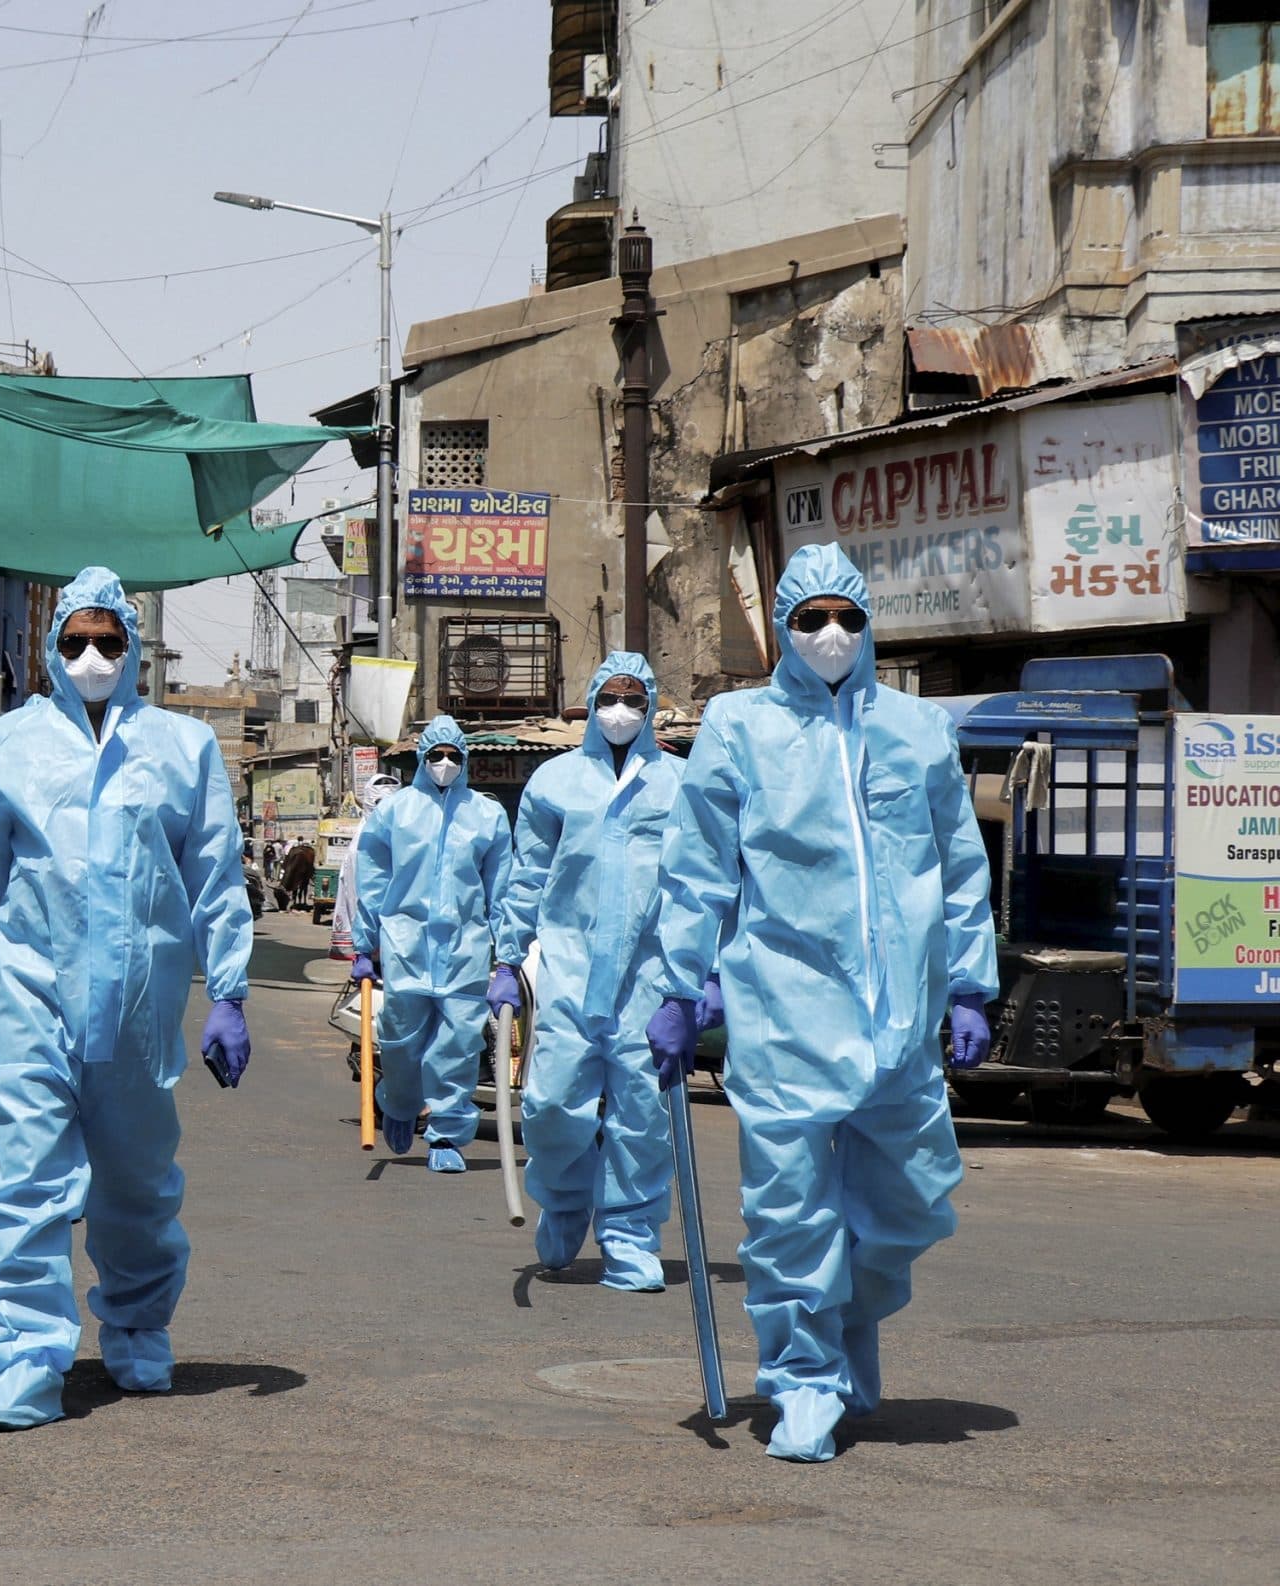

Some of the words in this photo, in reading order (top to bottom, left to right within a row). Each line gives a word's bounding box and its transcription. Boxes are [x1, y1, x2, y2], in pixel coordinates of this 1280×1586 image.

[786, 486, 823, 526] CFM
[831, 441, 1011, 536] CAPITAL
[1214, 487, 1280, 511] GHAR
[889, 525, 1004, 581] MAKERS
[1050, 549, 1162, 597] મેકર્સ
[877, 592, 912, 617] PHOTO
[915, 589, 961, 616] FRAME
[1184, 736, 1237, 758] issa
[1243, 722, 1280, 756] is
[1238, 817, 1280, 836] JAM
[1185, 893, 1237, 939] LOCK
